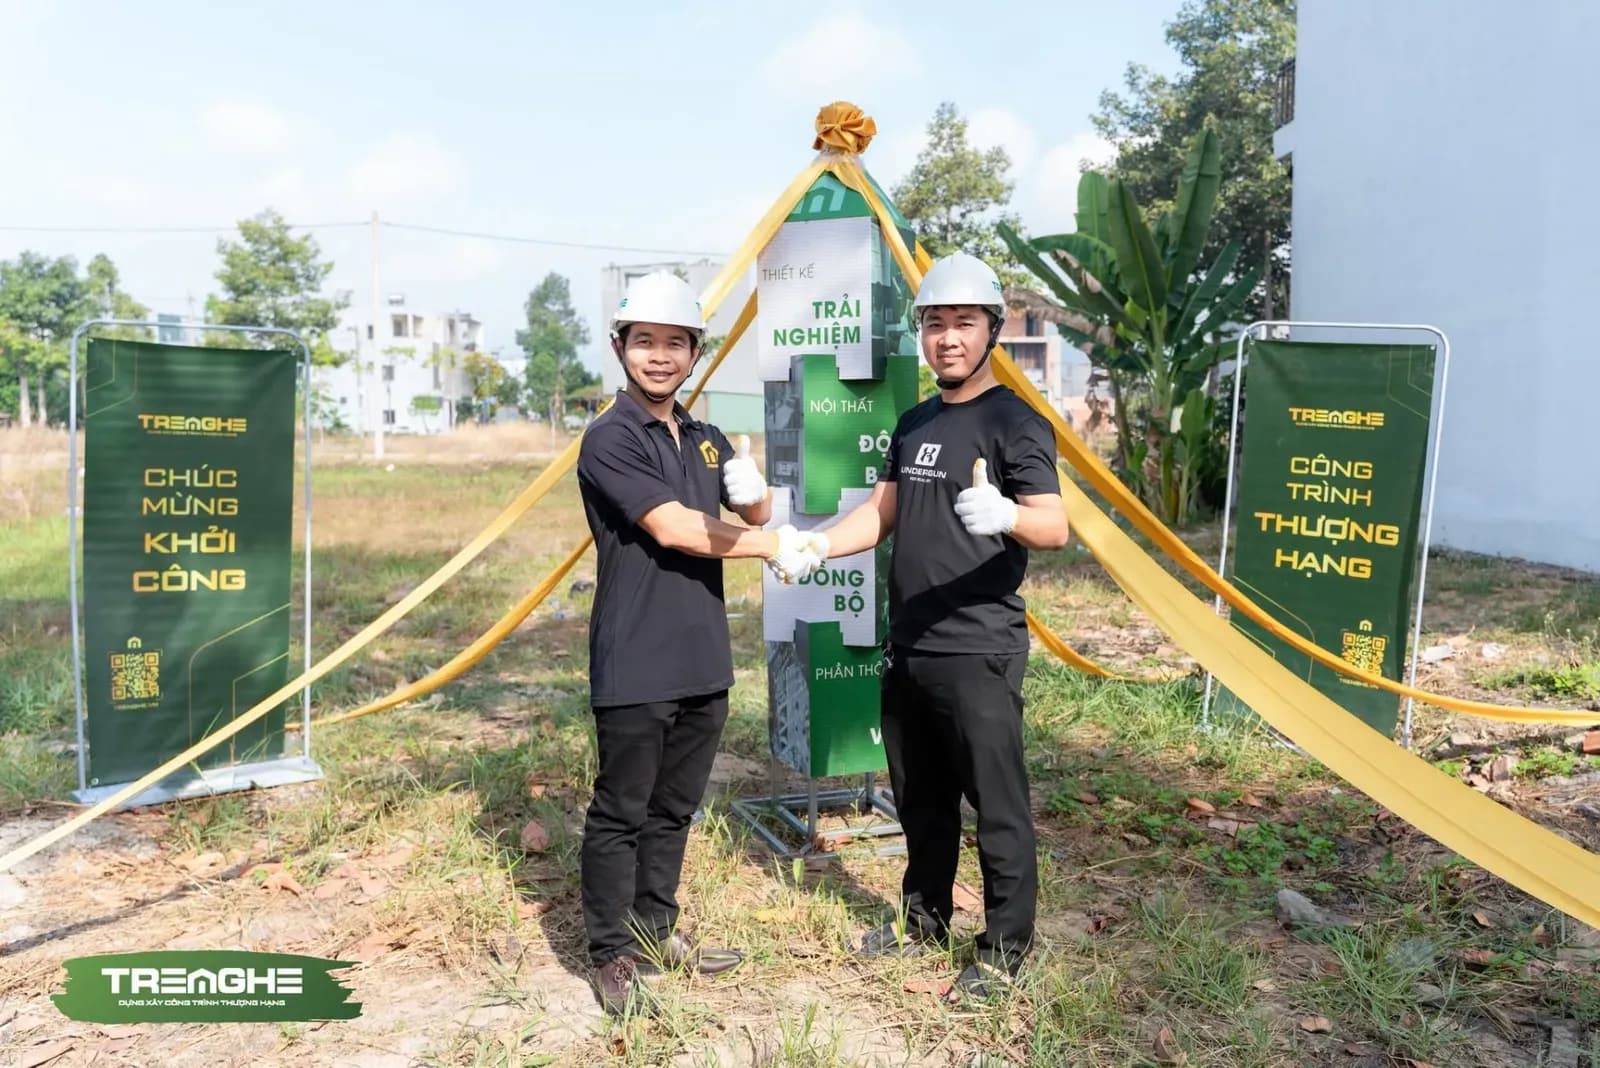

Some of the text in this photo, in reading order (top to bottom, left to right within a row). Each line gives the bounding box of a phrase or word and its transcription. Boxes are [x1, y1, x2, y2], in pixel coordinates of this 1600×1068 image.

[762, 263, 815, 281] THIẾT KẾ
[812, 293, 860, 319] TRẢI
[773, 321, 860, 350] NGHIỆM
[810, 396, 874, 415] NỘI THẤT
[858, 429, 892, 458] ĐỘ
[143, 464, 238, 488] CHÚC
[1290, 454, 1373, 480] CÔNG
[142, 492, 239, 516] MỪNG
[1287, 480, 1372, 507] TRÌNH
[144, 525, 236, 554] KHỞI
[1254, 512, 1400, 547] THƯỢNG
[132, 564, 246, 592] CÔNG
[1275, 549, 1373, 580] HẠNG
[834, 590, 865, 618] BỘ
[815, 662, 854, 680] PHẦN
